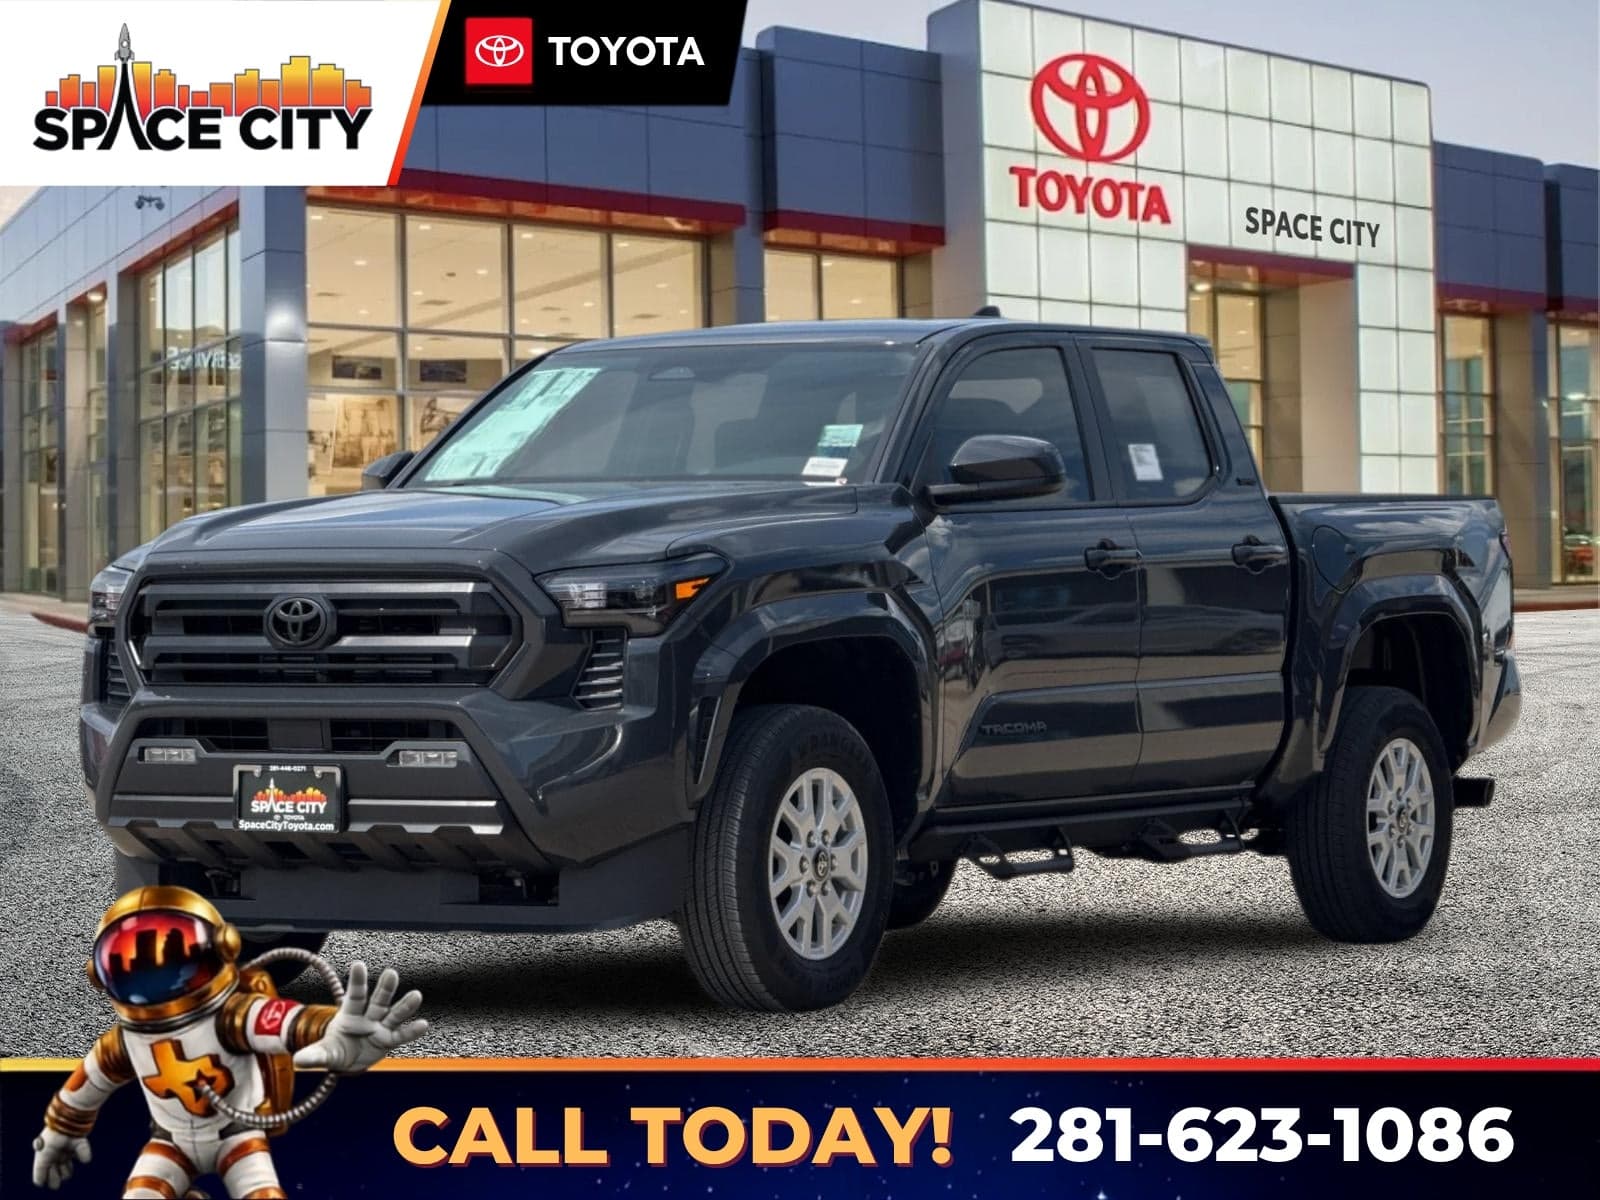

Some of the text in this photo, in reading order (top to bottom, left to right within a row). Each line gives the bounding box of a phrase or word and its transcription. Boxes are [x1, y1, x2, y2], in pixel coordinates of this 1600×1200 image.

[1009, 166, 1172, 224] TOYOTA
[1245, 206, 1381, 248] SPACE CITY
[250, 801, 327, 814] SPACE CITY
[238, 820, 335, 831] SpaceCityToyota.com
